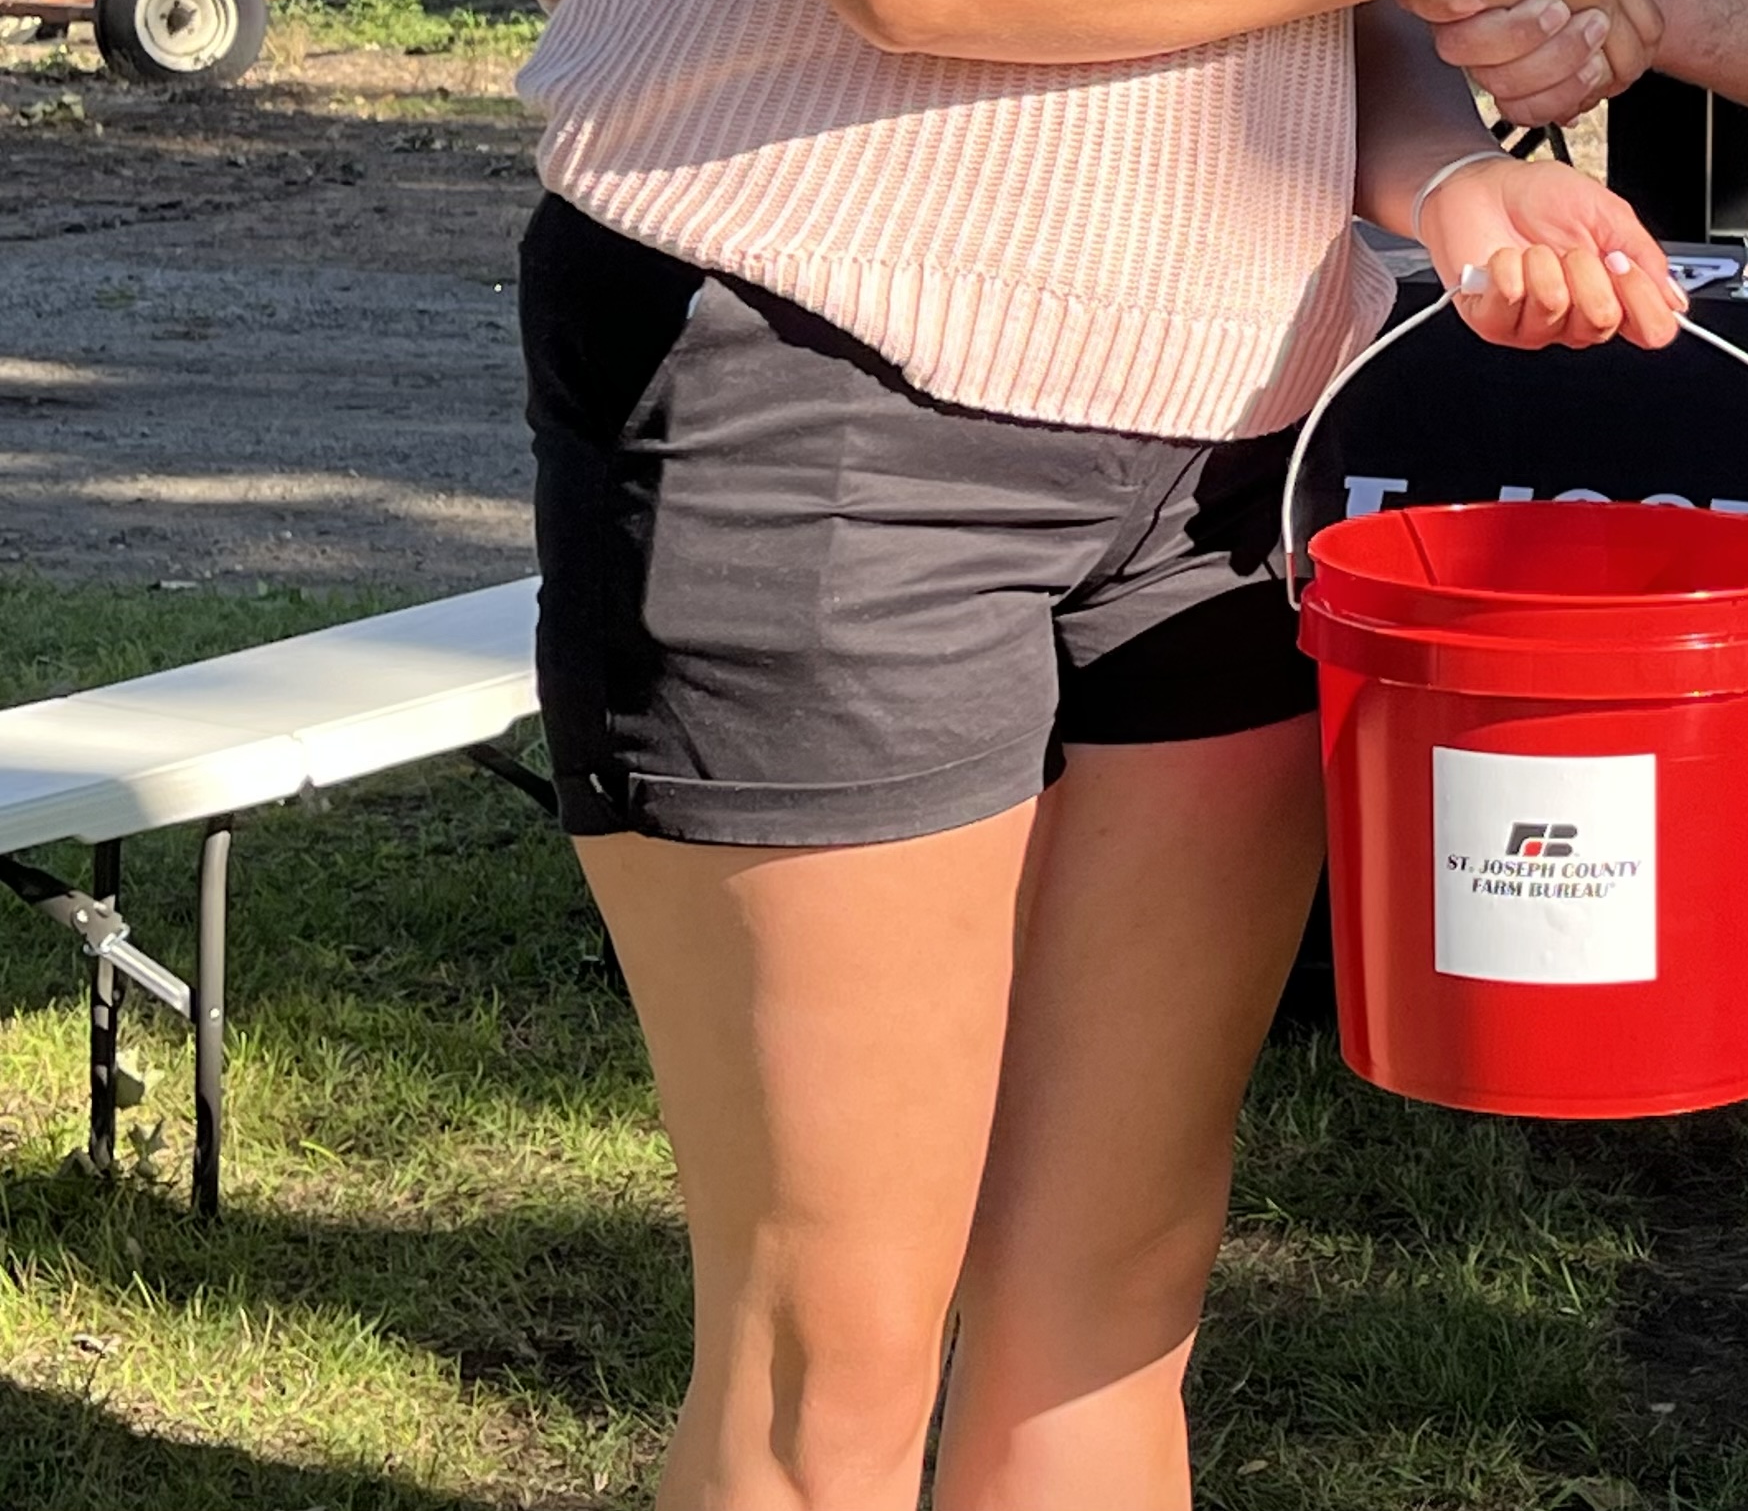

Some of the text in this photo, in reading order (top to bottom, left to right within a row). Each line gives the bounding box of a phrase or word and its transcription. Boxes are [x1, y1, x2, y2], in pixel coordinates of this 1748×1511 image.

[1446, 854, 1641, 879] ST. JOSEPH COUNTY
[1471, 877, 1523, 898] FARM
